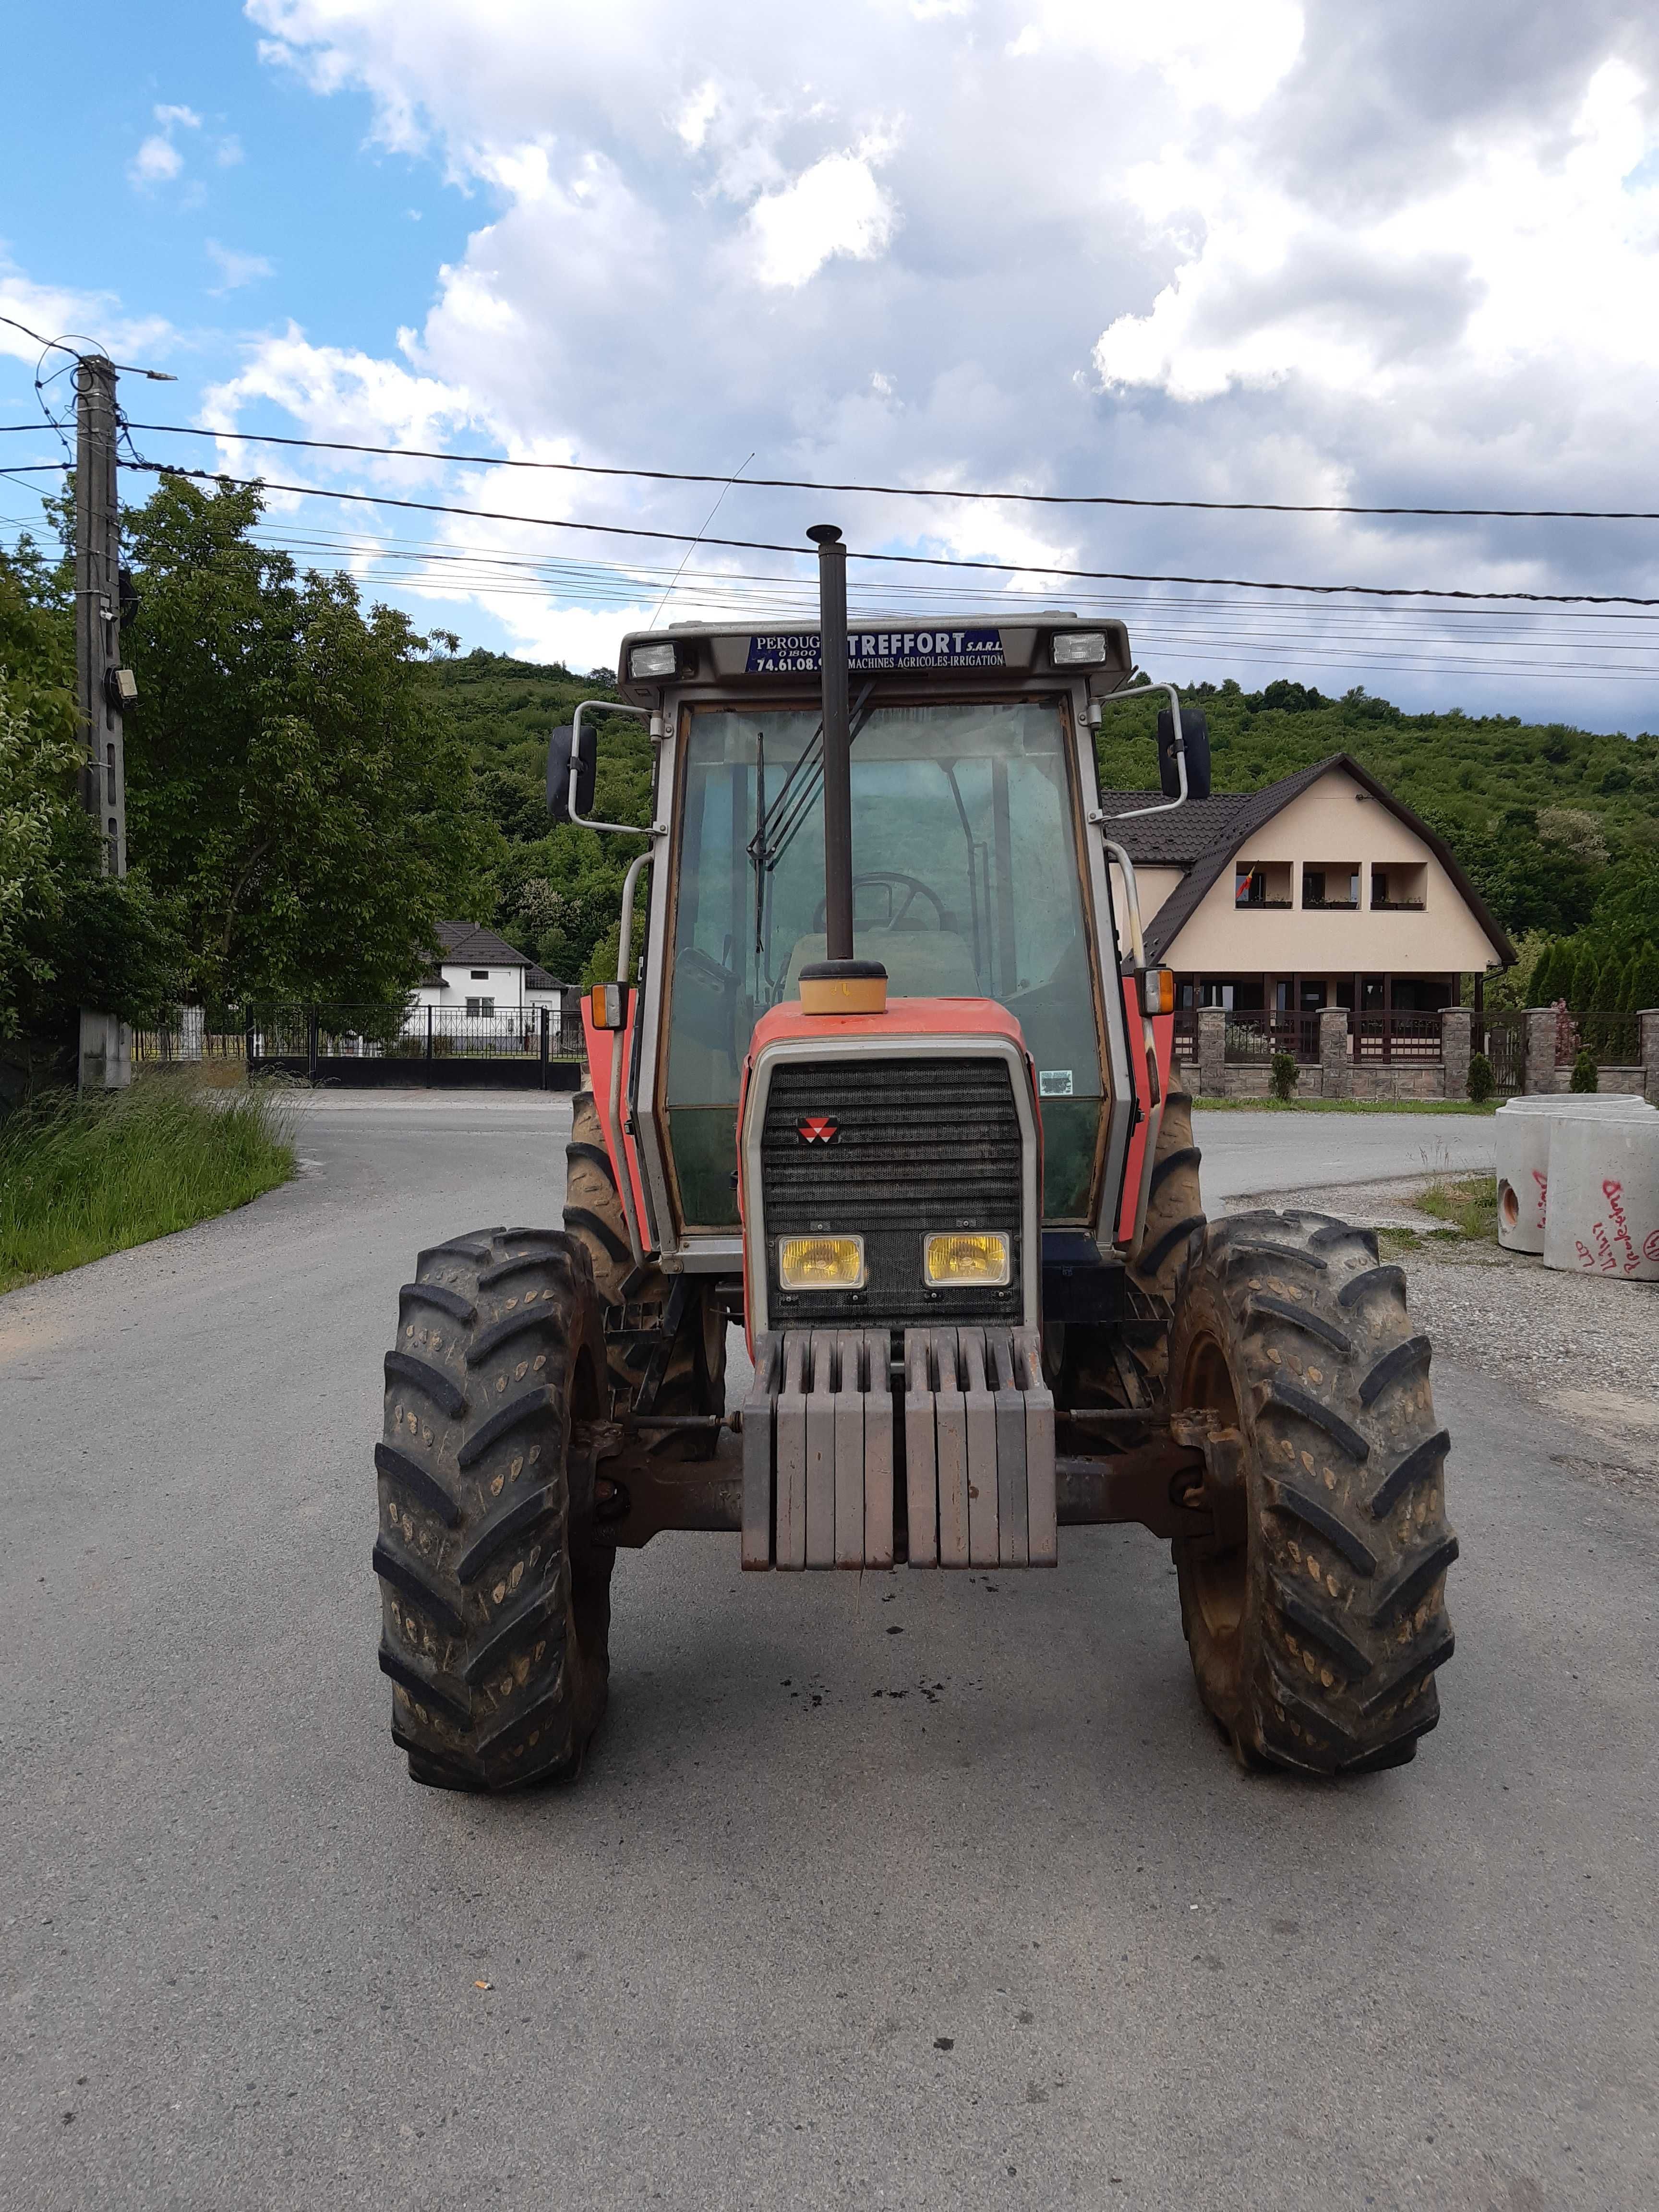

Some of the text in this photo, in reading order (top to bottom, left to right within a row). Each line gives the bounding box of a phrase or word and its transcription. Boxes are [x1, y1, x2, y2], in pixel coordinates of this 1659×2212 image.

[757, 636, 820, 649] PEROUG
[847, 632, 1003, 656] TREFFORT S.A.R.L.
[848, 657, 894, 669] MACHINES
